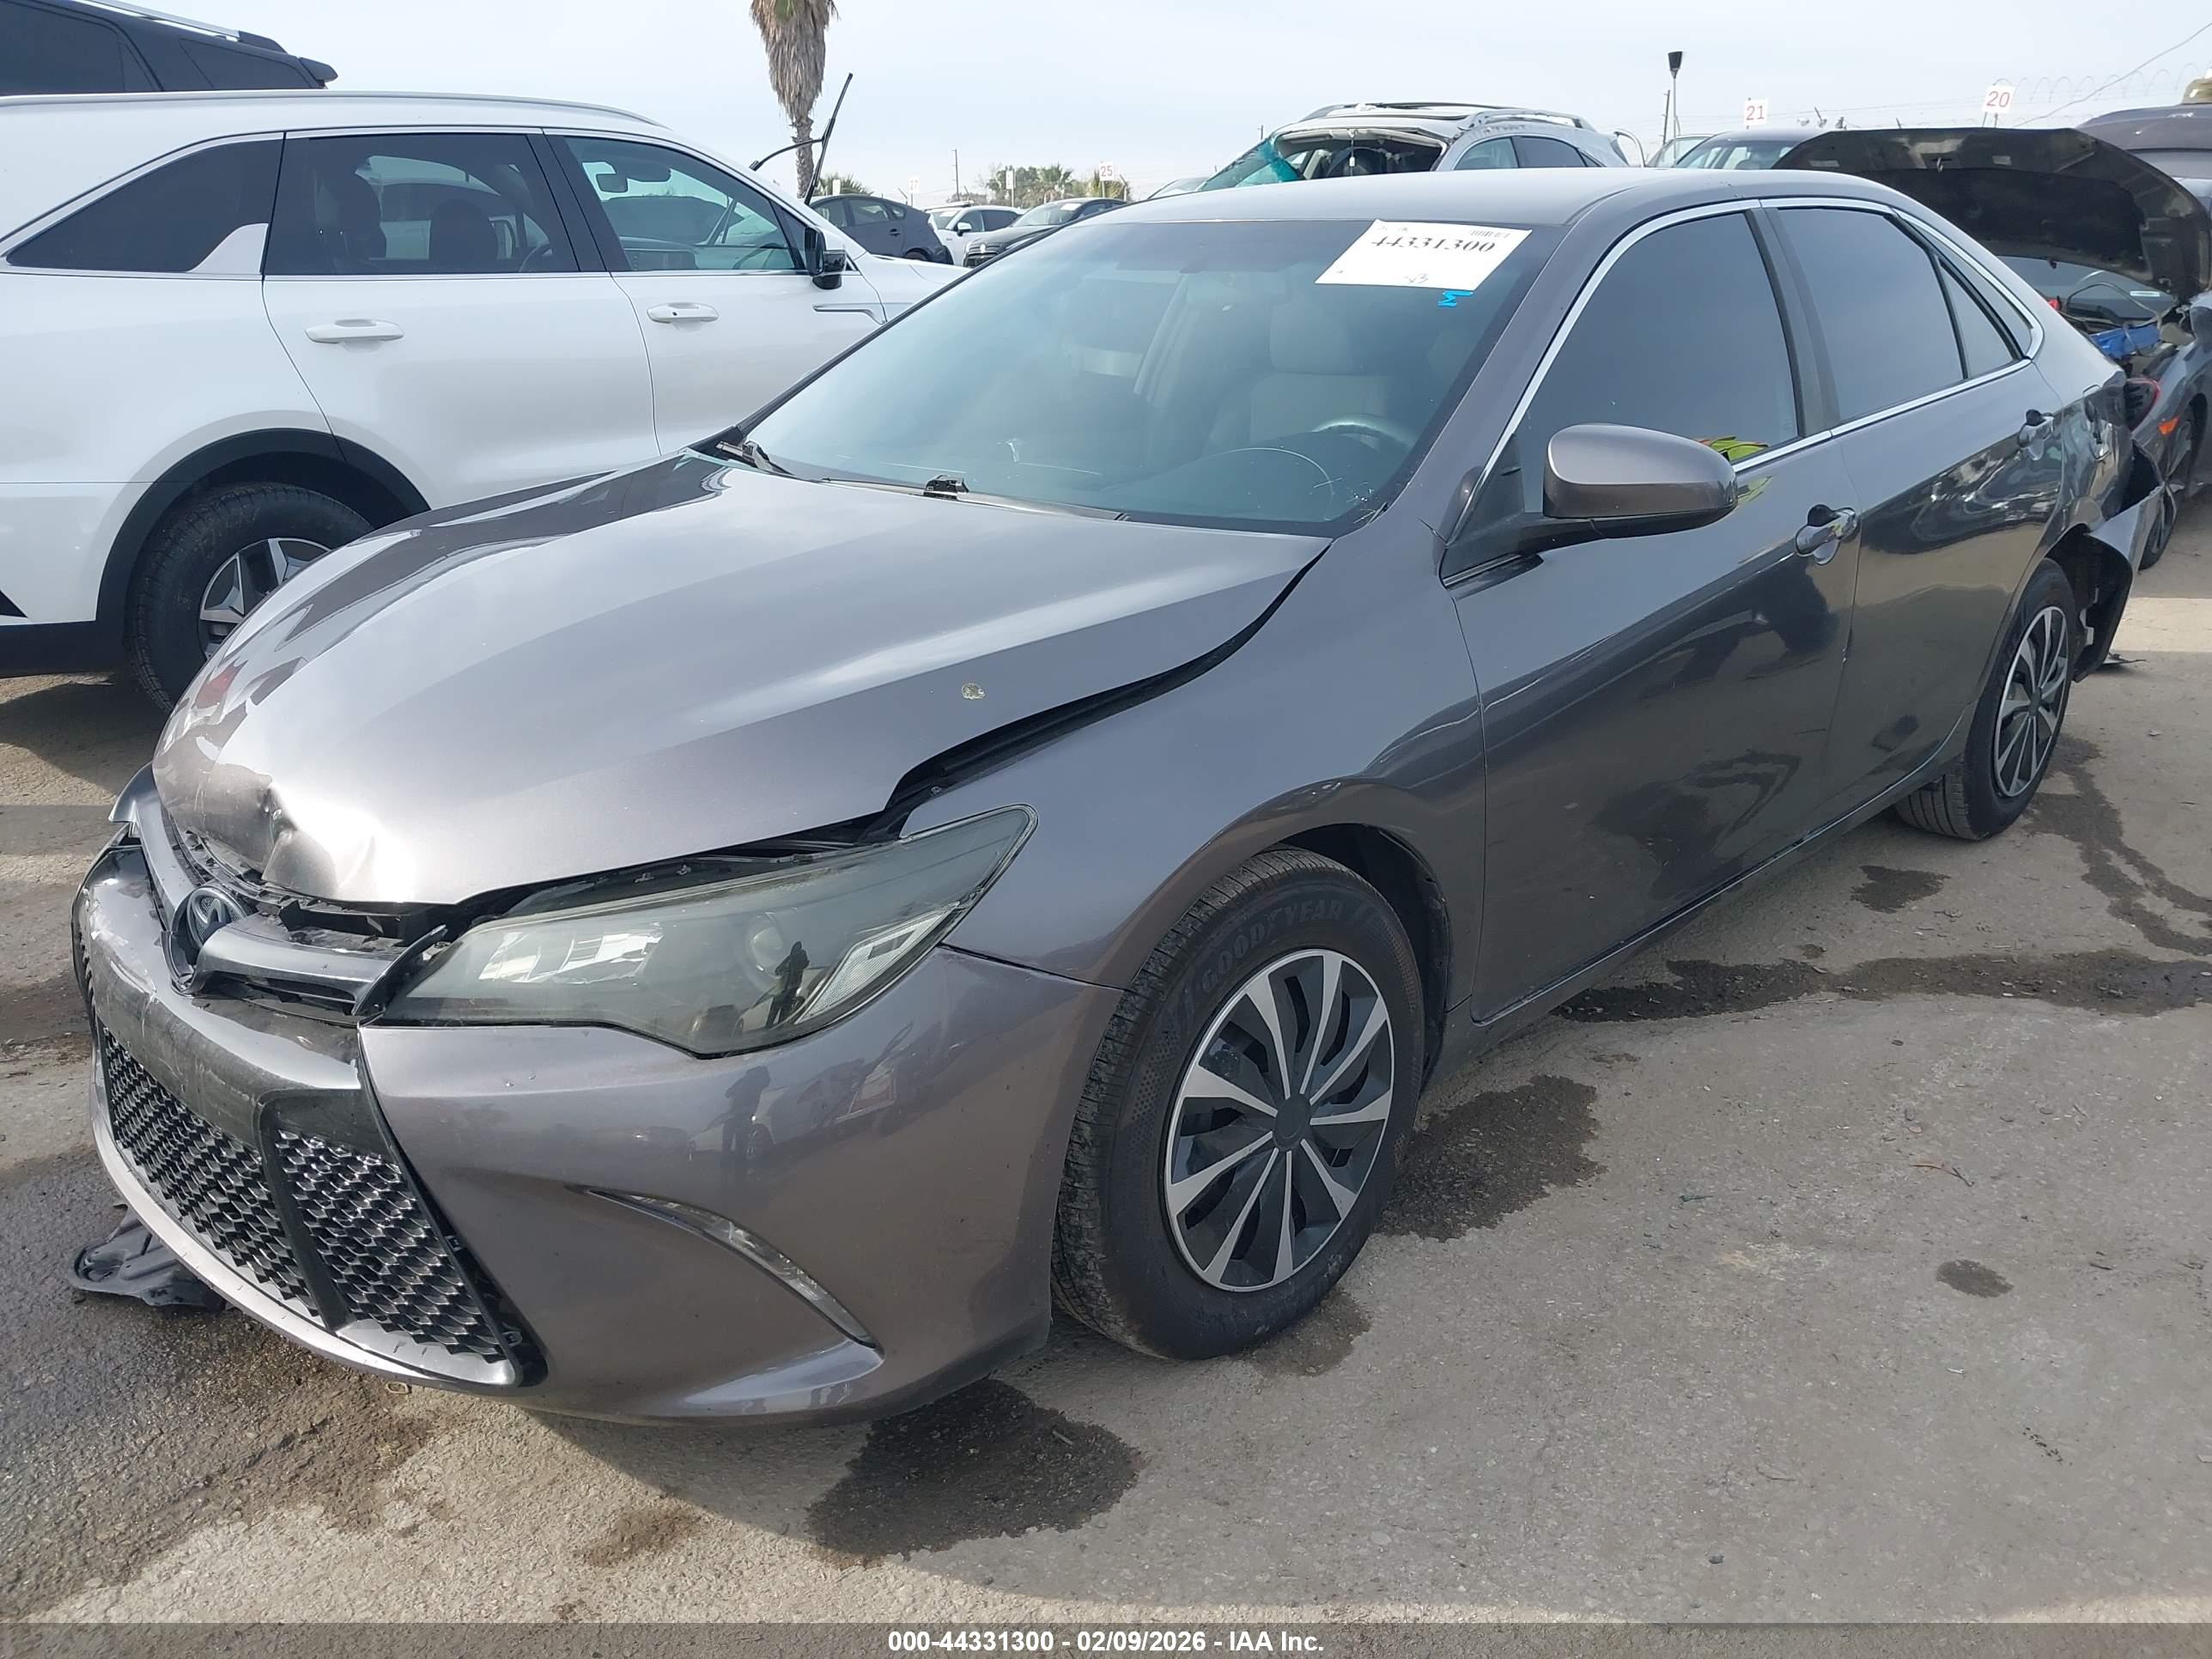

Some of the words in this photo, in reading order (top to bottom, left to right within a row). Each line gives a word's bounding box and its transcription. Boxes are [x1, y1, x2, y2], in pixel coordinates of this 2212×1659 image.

[1986, 90, 2010, 108] 20
[1745, 105, 1765, 121] 21
[1101, 165, 1113, 178] 25
[1371, 235, 1496, 252] 44331300
